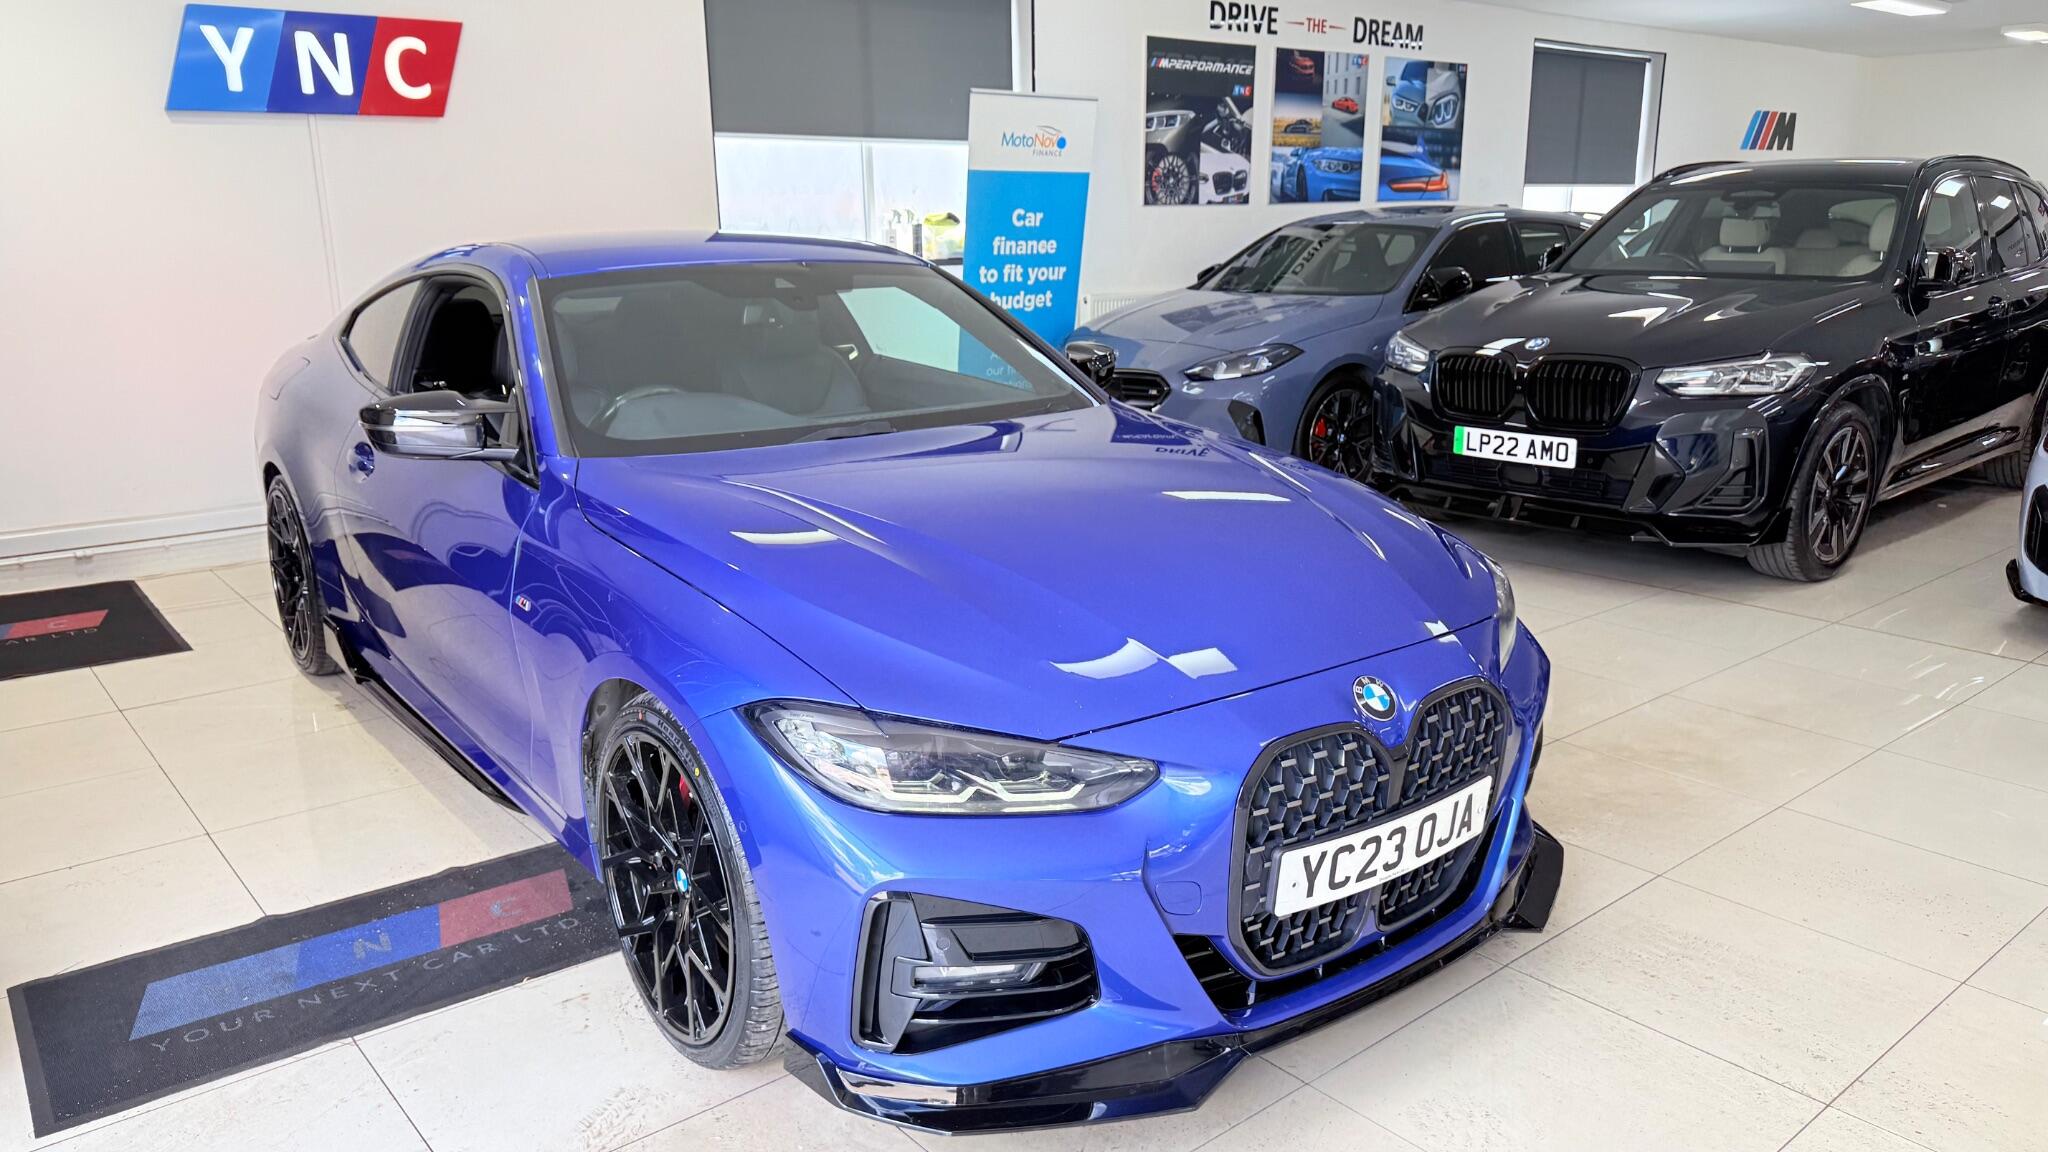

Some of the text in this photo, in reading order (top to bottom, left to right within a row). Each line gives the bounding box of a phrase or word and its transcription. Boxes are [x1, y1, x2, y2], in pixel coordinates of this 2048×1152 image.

[1209, 0, 1424, 50] DRIVE THE DREAM
[199, 24, 433, 100] YNC
[1032, 150, 1062, 158] FINANCE
[1012, 208, 1044, 228] Car
[992, 236, 1057, 256] finance
[979, 264, 1067, 286] to fit your
[1466, 432, 1569, 462] LP22 AMO
[1302, 793, 1473, 898] YC23 OJA
[152, 917, 579, 1052] YOUR NEXT CAR LTD
